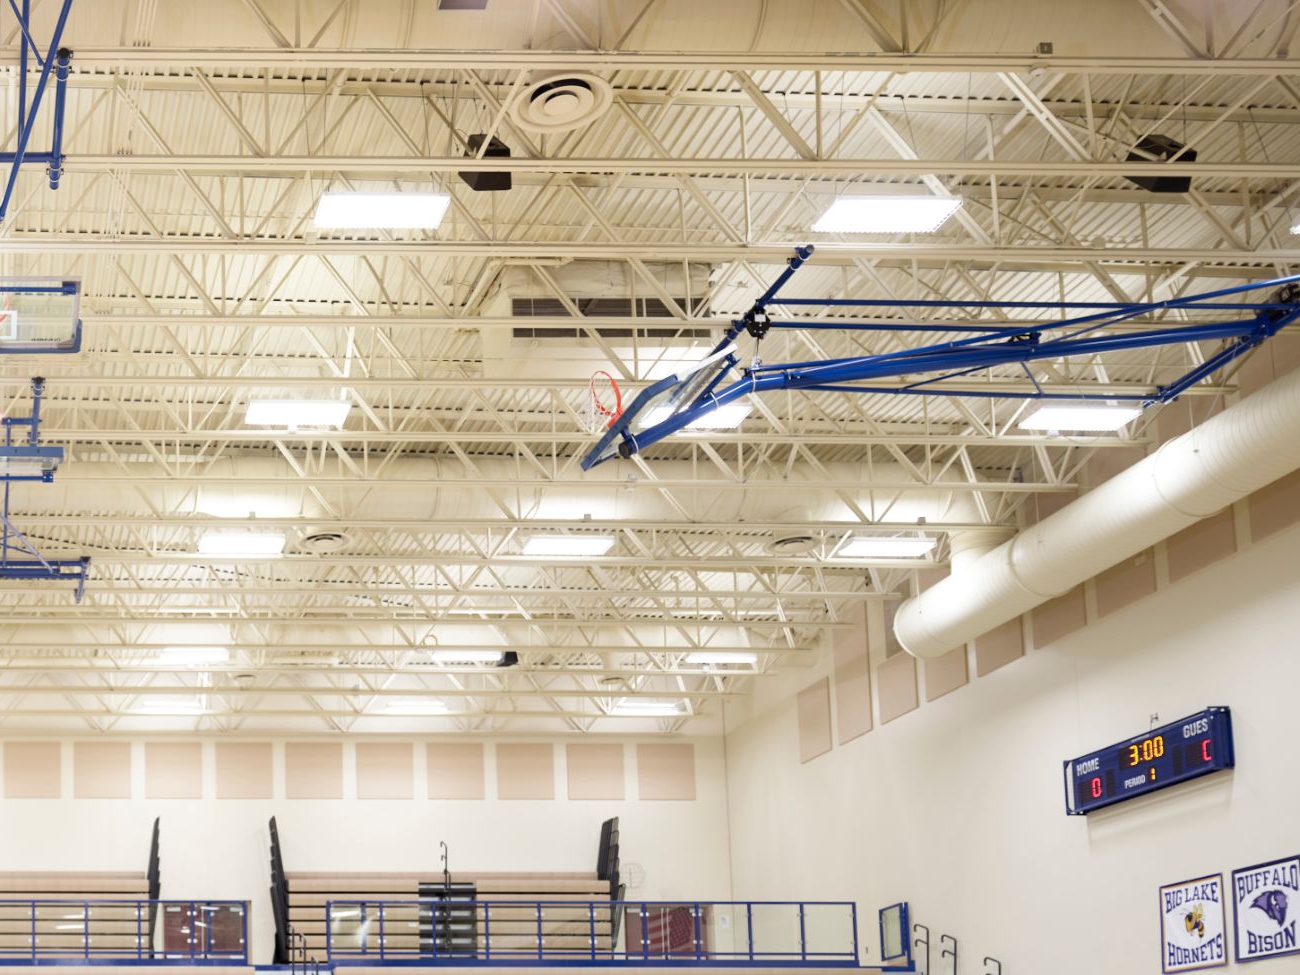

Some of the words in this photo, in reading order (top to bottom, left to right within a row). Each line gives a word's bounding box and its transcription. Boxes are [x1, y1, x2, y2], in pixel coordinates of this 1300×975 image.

[1183, 718, 1209, 739] GUES
[1129, 736, 1164, 766] 3:00
[1076, 758, 1100, 776] HOME
[1151, 768, 1156, 780] 1
[1092, 777, 1102, 798] 0
[1124, 775, 1146, 789] PERIOD
[1237, 864, 1299, 903] BUFFALO
[1164, 890, 1182, 913] BIG
[1185, 882, 1219, 903] LAKE
[1167, 933, 1223, 966] HORNETS
[1247, 920, 1296, 954] BISON
